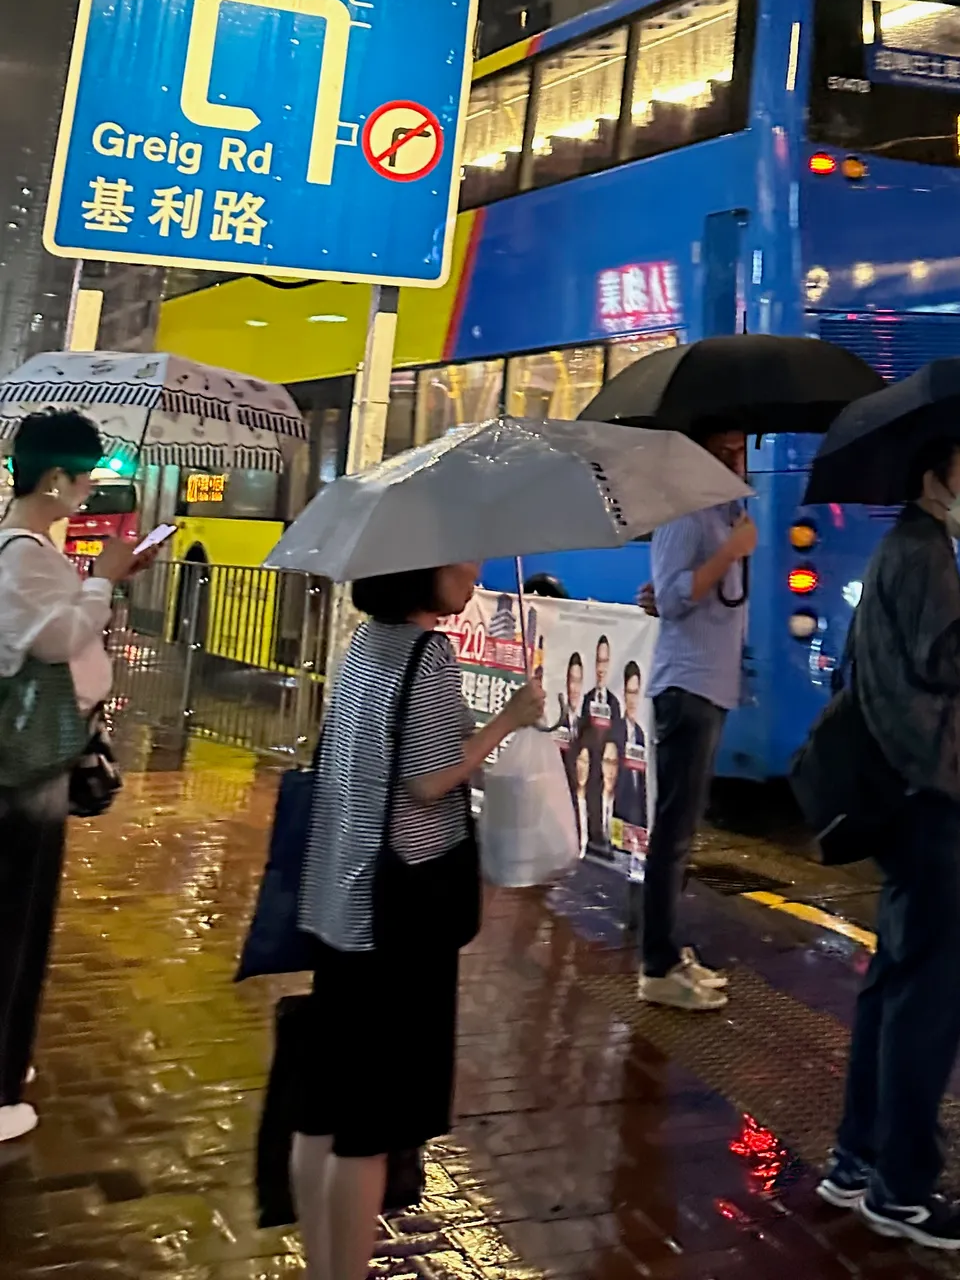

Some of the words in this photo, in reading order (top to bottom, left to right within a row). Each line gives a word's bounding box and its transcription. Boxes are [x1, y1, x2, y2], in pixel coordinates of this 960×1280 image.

[92, 121, 203, 175] Greig
[218, 136, 273, 175] Rd
[81, 176, 268, 246] 基利路
